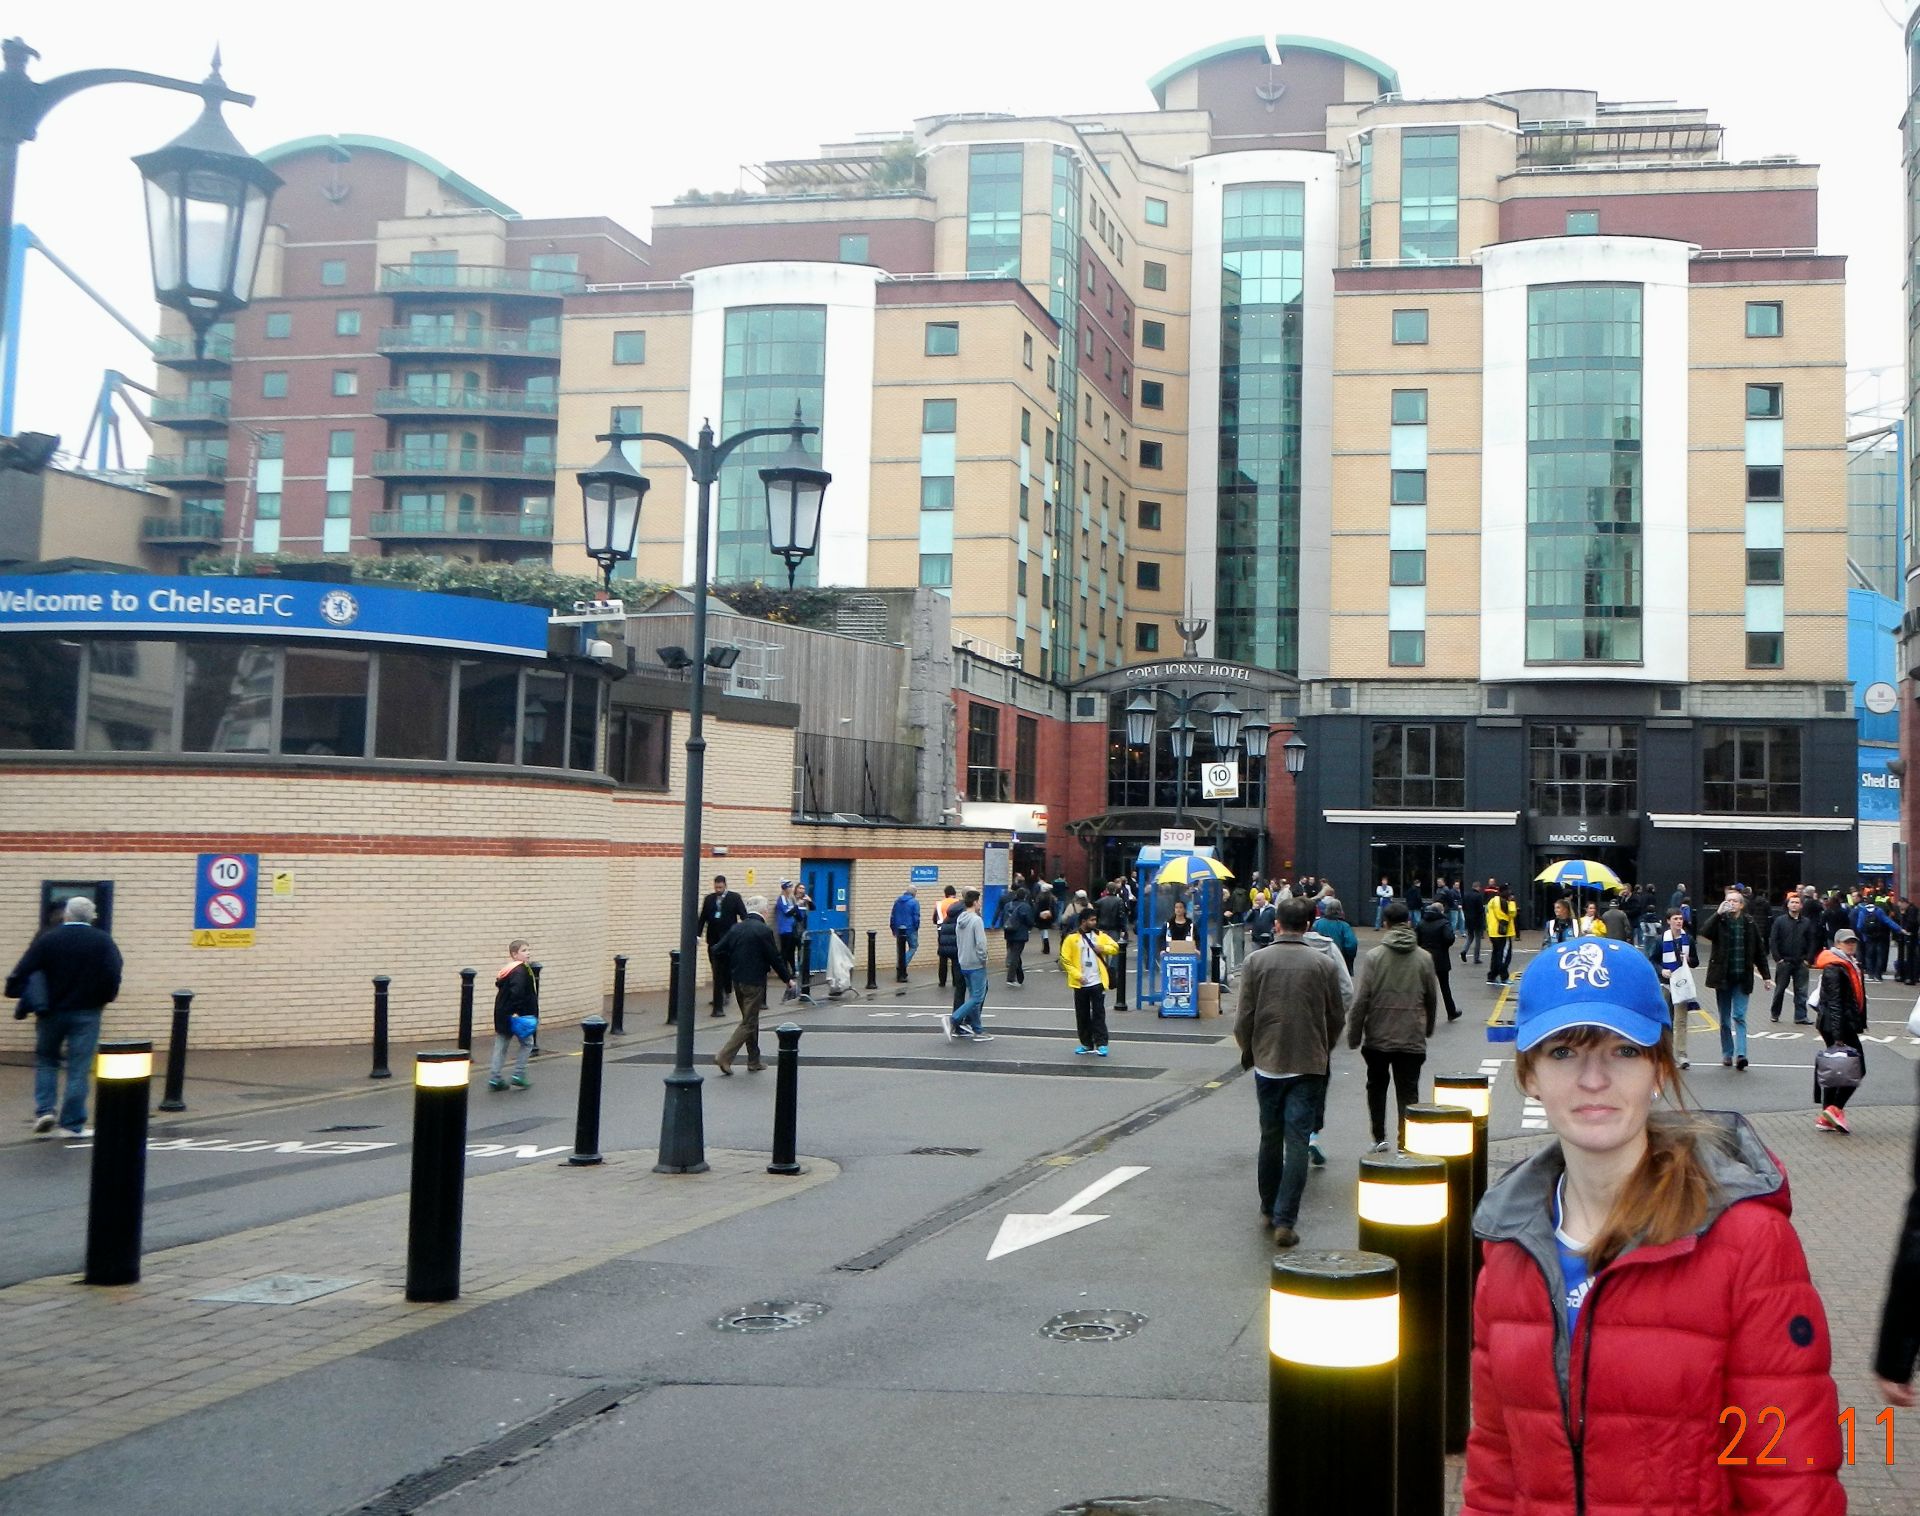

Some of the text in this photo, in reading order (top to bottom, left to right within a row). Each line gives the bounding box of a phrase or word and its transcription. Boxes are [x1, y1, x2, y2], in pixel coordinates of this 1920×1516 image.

[110, 589, 139, 612] to
[148, 589, 294, 617] ChelseaFC
[1210, 665, 1250, 681] HOTEL
[1213, 769, 1227, 781] 10
[1861, 772, 1900, 789] Shed En
[1163, 831, 1192, 841] STOP
[1549, 834, 1616, 843] MARCO GRILL
[216, 863, 239, 880] 10
